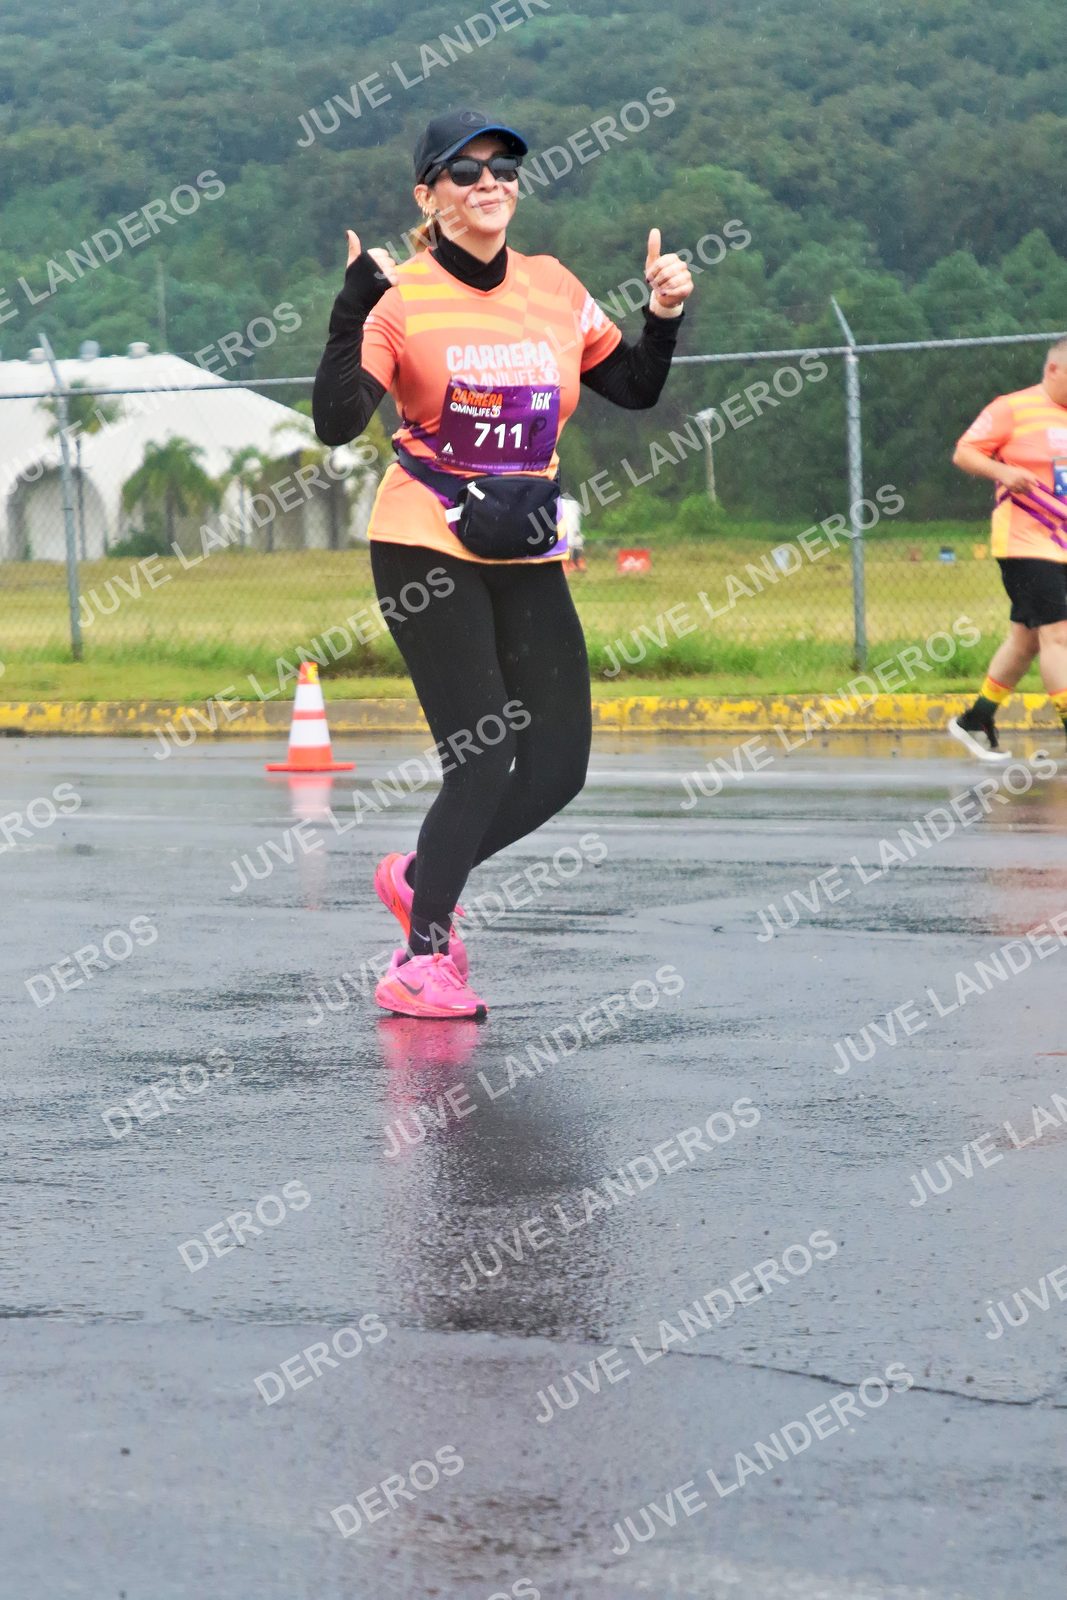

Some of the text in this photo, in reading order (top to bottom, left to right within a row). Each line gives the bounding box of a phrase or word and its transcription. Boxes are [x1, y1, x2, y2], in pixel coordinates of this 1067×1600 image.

[446, 341, 557, 372] CARRERA
[451, 387, 504, 408] CARRERA
[450, 402, 491, 418] OMNILIFE
[474, 422, 523, 449] 711
